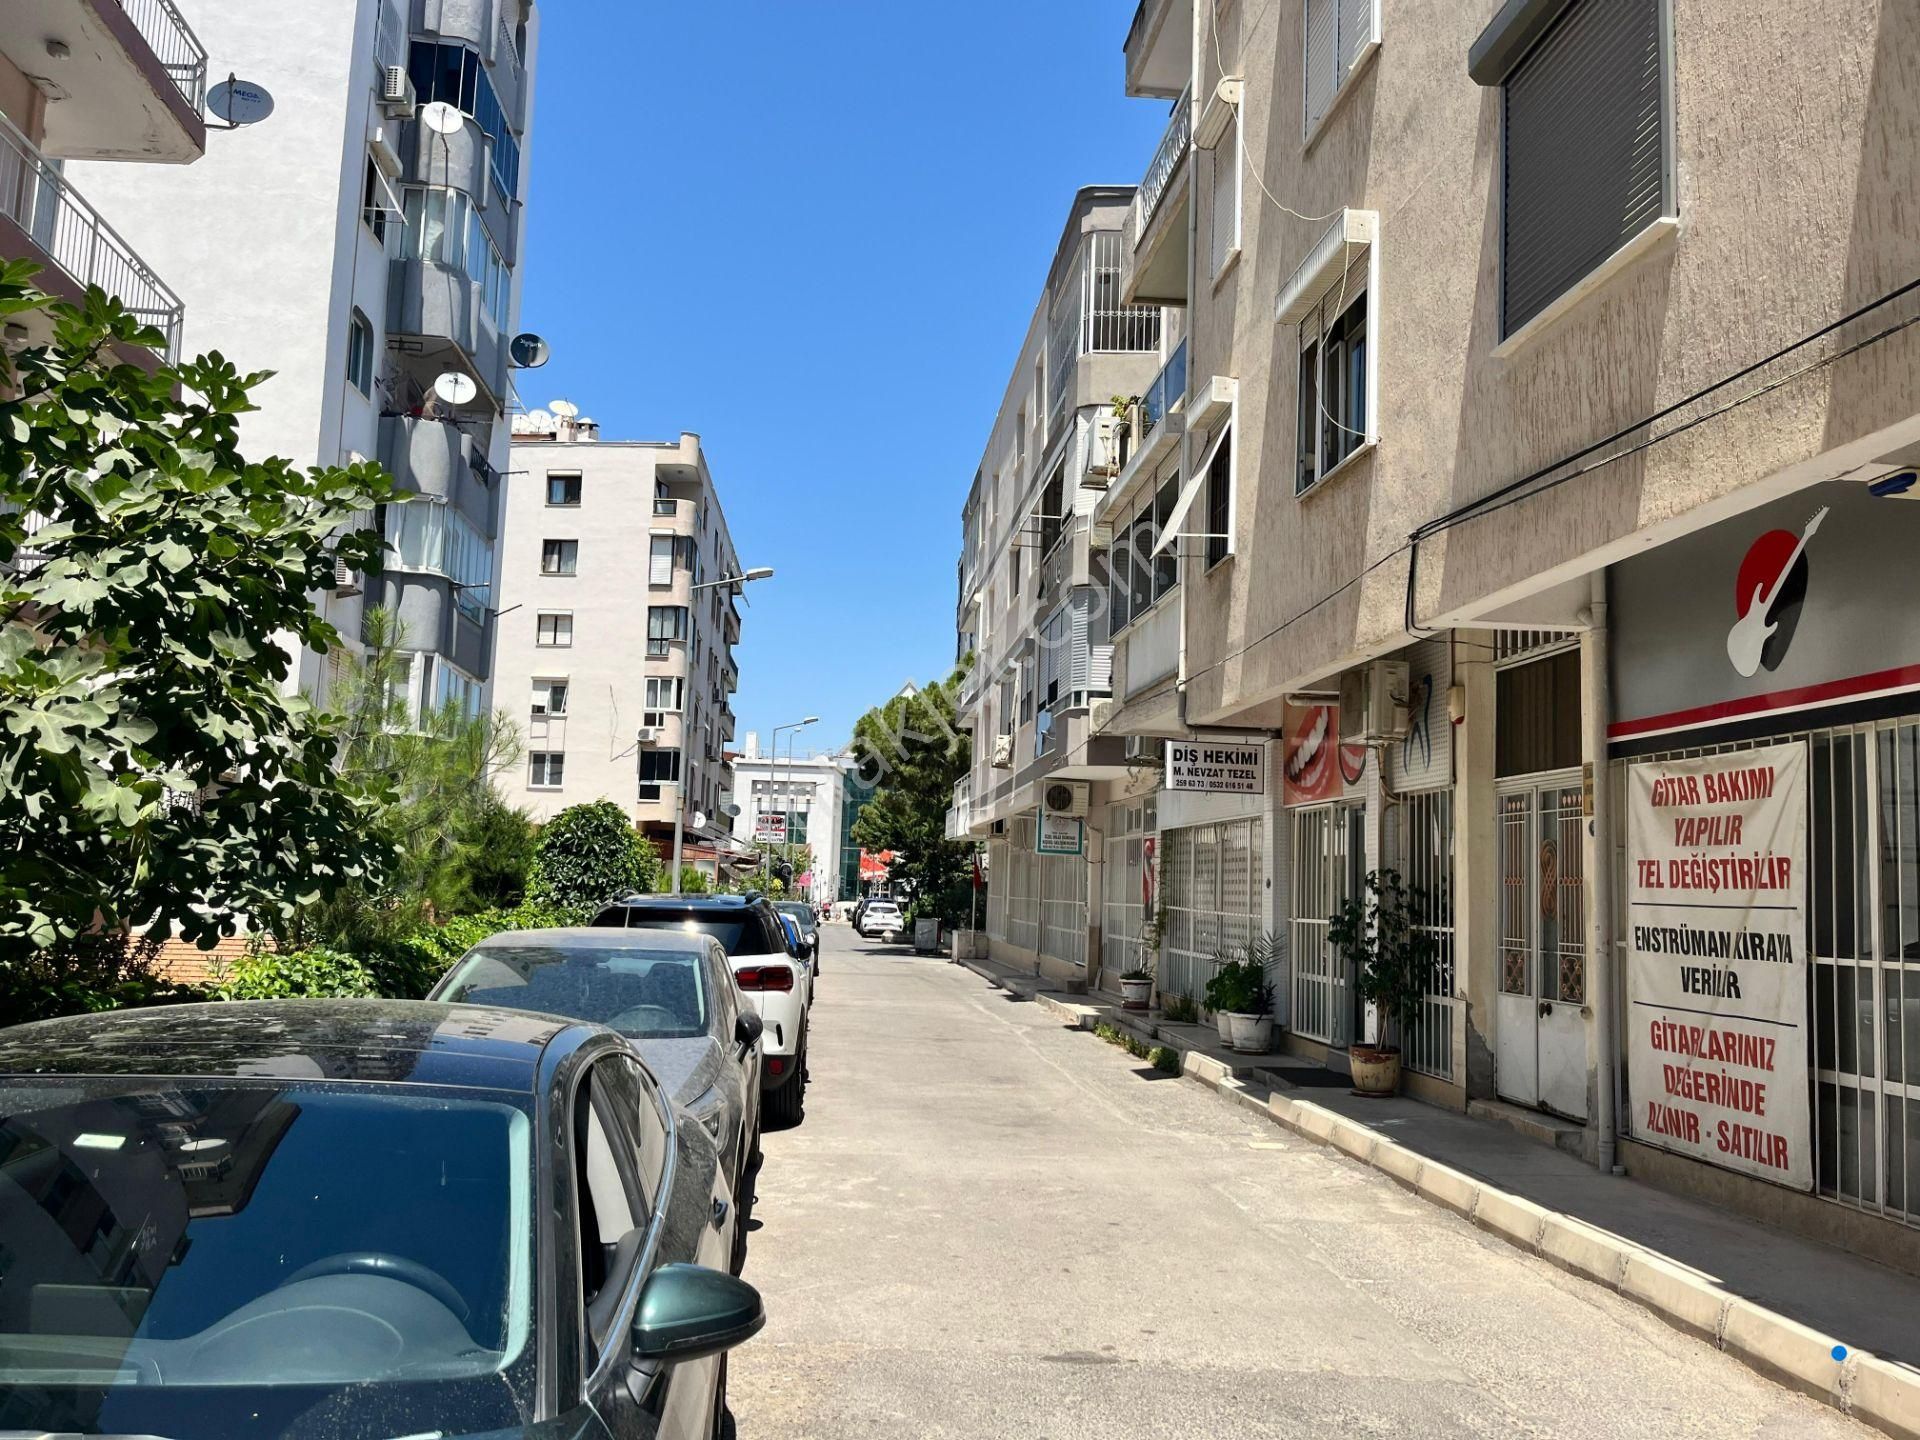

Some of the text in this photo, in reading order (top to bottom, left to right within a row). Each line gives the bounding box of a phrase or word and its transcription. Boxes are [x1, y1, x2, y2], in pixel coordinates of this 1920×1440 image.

[1173, 745, 1258, 767] DİŞ HEKİMİ
[1173, 766, 1257, 780] M. NEVZAT TEZEL
[1197, 780, 1205, 788] 73
[1209, 781, 1224, 789] 0532
[1651, 766, 1775, 807] GİTAR BAKIMI
[1674, 814, 1743, 847] YAPILIR
[1637, 851, 1791, 894] TEL DEĞİŞTİRİLİR
[1634, 923, 1794, 964] ENSTRÜMAN KİRAYA
[1680, 963, 1742, 999] VERİLİR
[1650, 1016, 1776, 1072] GİTARLARINIZ
[1646, 1101, 1700, 1144] ALINIR
[1717, 1119, 1789, 1170] SATILIR
